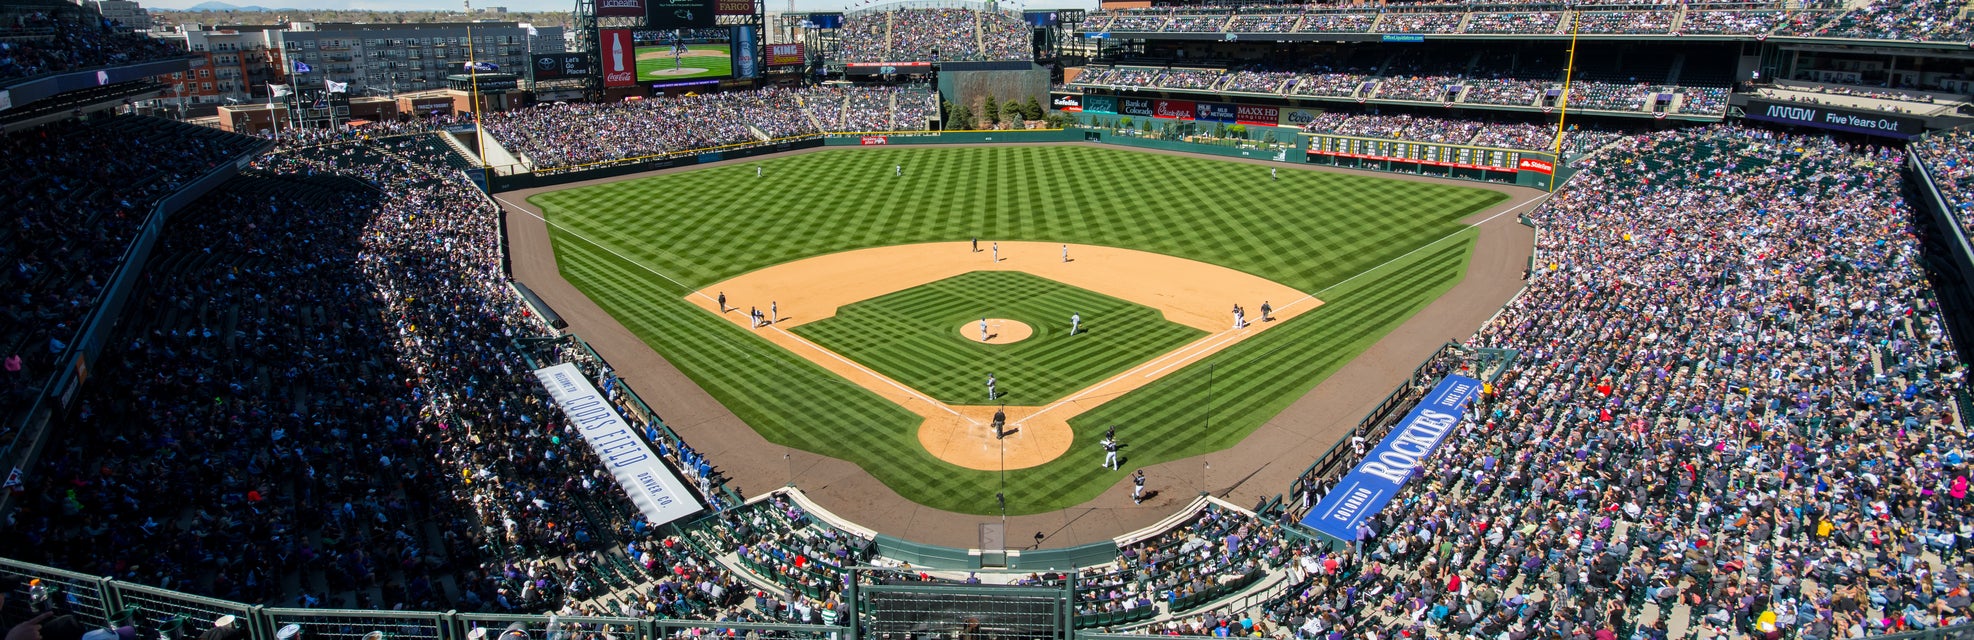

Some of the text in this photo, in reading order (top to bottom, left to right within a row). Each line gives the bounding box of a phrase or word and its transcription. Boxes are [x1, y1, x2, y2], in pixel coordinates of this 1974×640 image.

[720, 3, 749, 11] FARGO
[773, 44, 797, 56] KING
[1054, 98, 1078, 106] Safelite
[1125, 107, 1153, 115] Colorado
[1237, 106, 1278, 117] MAXX HD
[1287, 111, 1314, 123] Coor
[1826, 113, 1848, 125] Five
[1848, 115, 1876, 128] Years
[1878, 119, 1898, 131] Out
[554, 372, 573, 388] WELCOME
[1441, 383, 1470, 407] SINCE 1993
[566, 394, 649, 468] COORS FIELD
[1359, 408, 1457, 485] ROCKIES
[637, 472, 673, 509] DENVER, CO.
[1333, 487, 1372, 522] COLORADO
